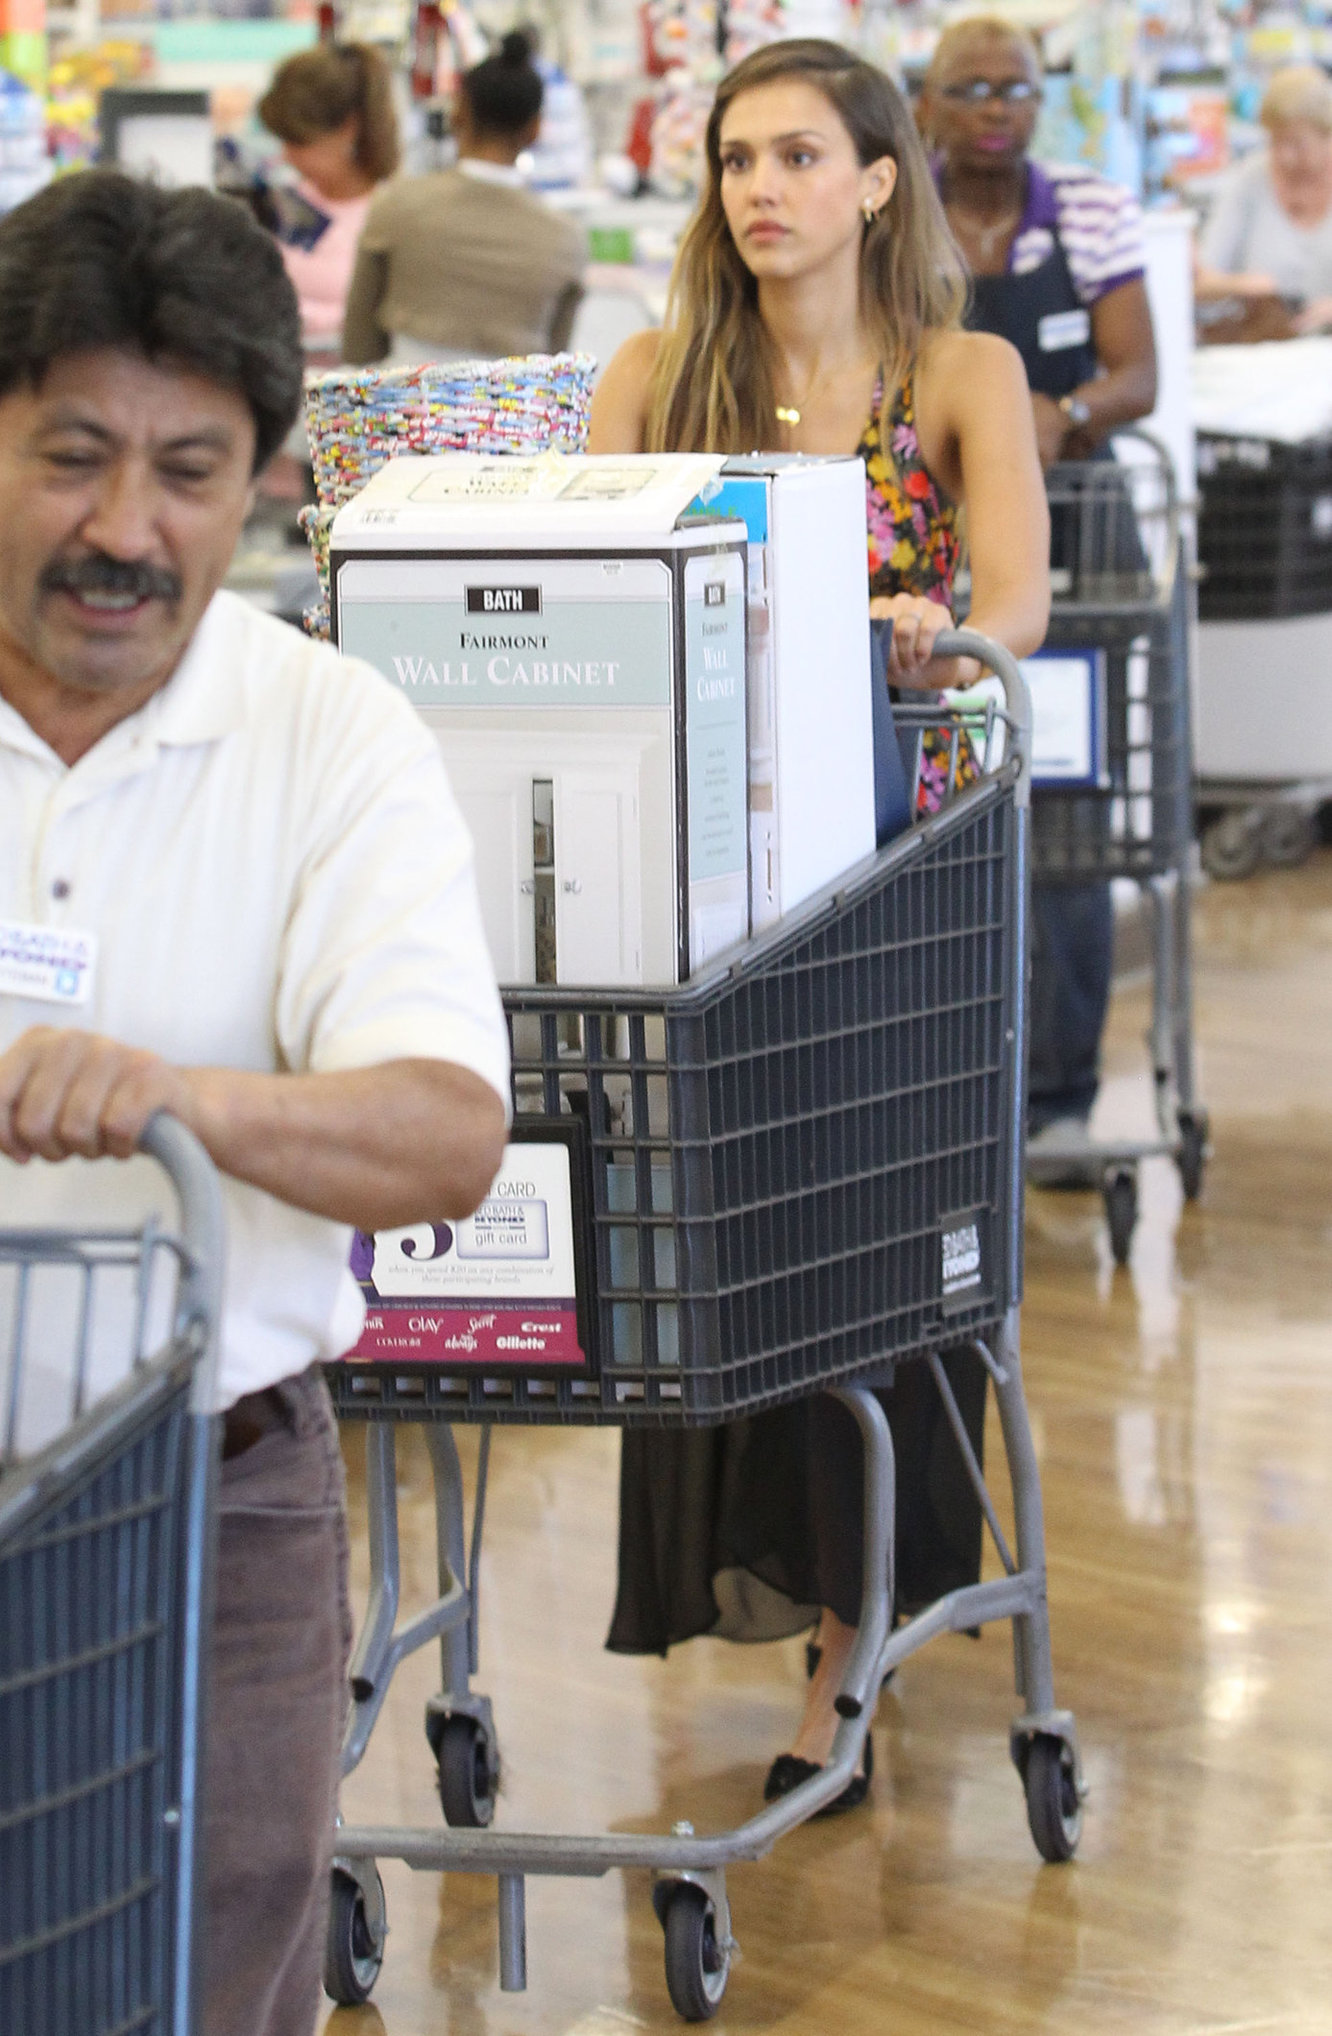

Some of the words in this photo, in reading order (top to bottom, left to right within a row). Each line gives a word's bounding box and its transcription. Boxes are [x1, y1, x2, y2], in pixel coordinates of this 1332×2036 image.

[483, 589, 523, 611] BATH
[460, 632, 549, 649] FAIRMONT
[703, 648, 728, 671] WALL
[392, 655, 477, 686] WALL
[487, 654, 620, 686] CABINET
[697, 677, 736, 702] CABINET
[497, 1181, 536, 1197] CARD
[475, 1232, 494, 1247] gift
[499, 1232, 527, 1244] card
[521, 1321, 562, 1333] Crest
[496, 1335, 546, 1350] Gillette
